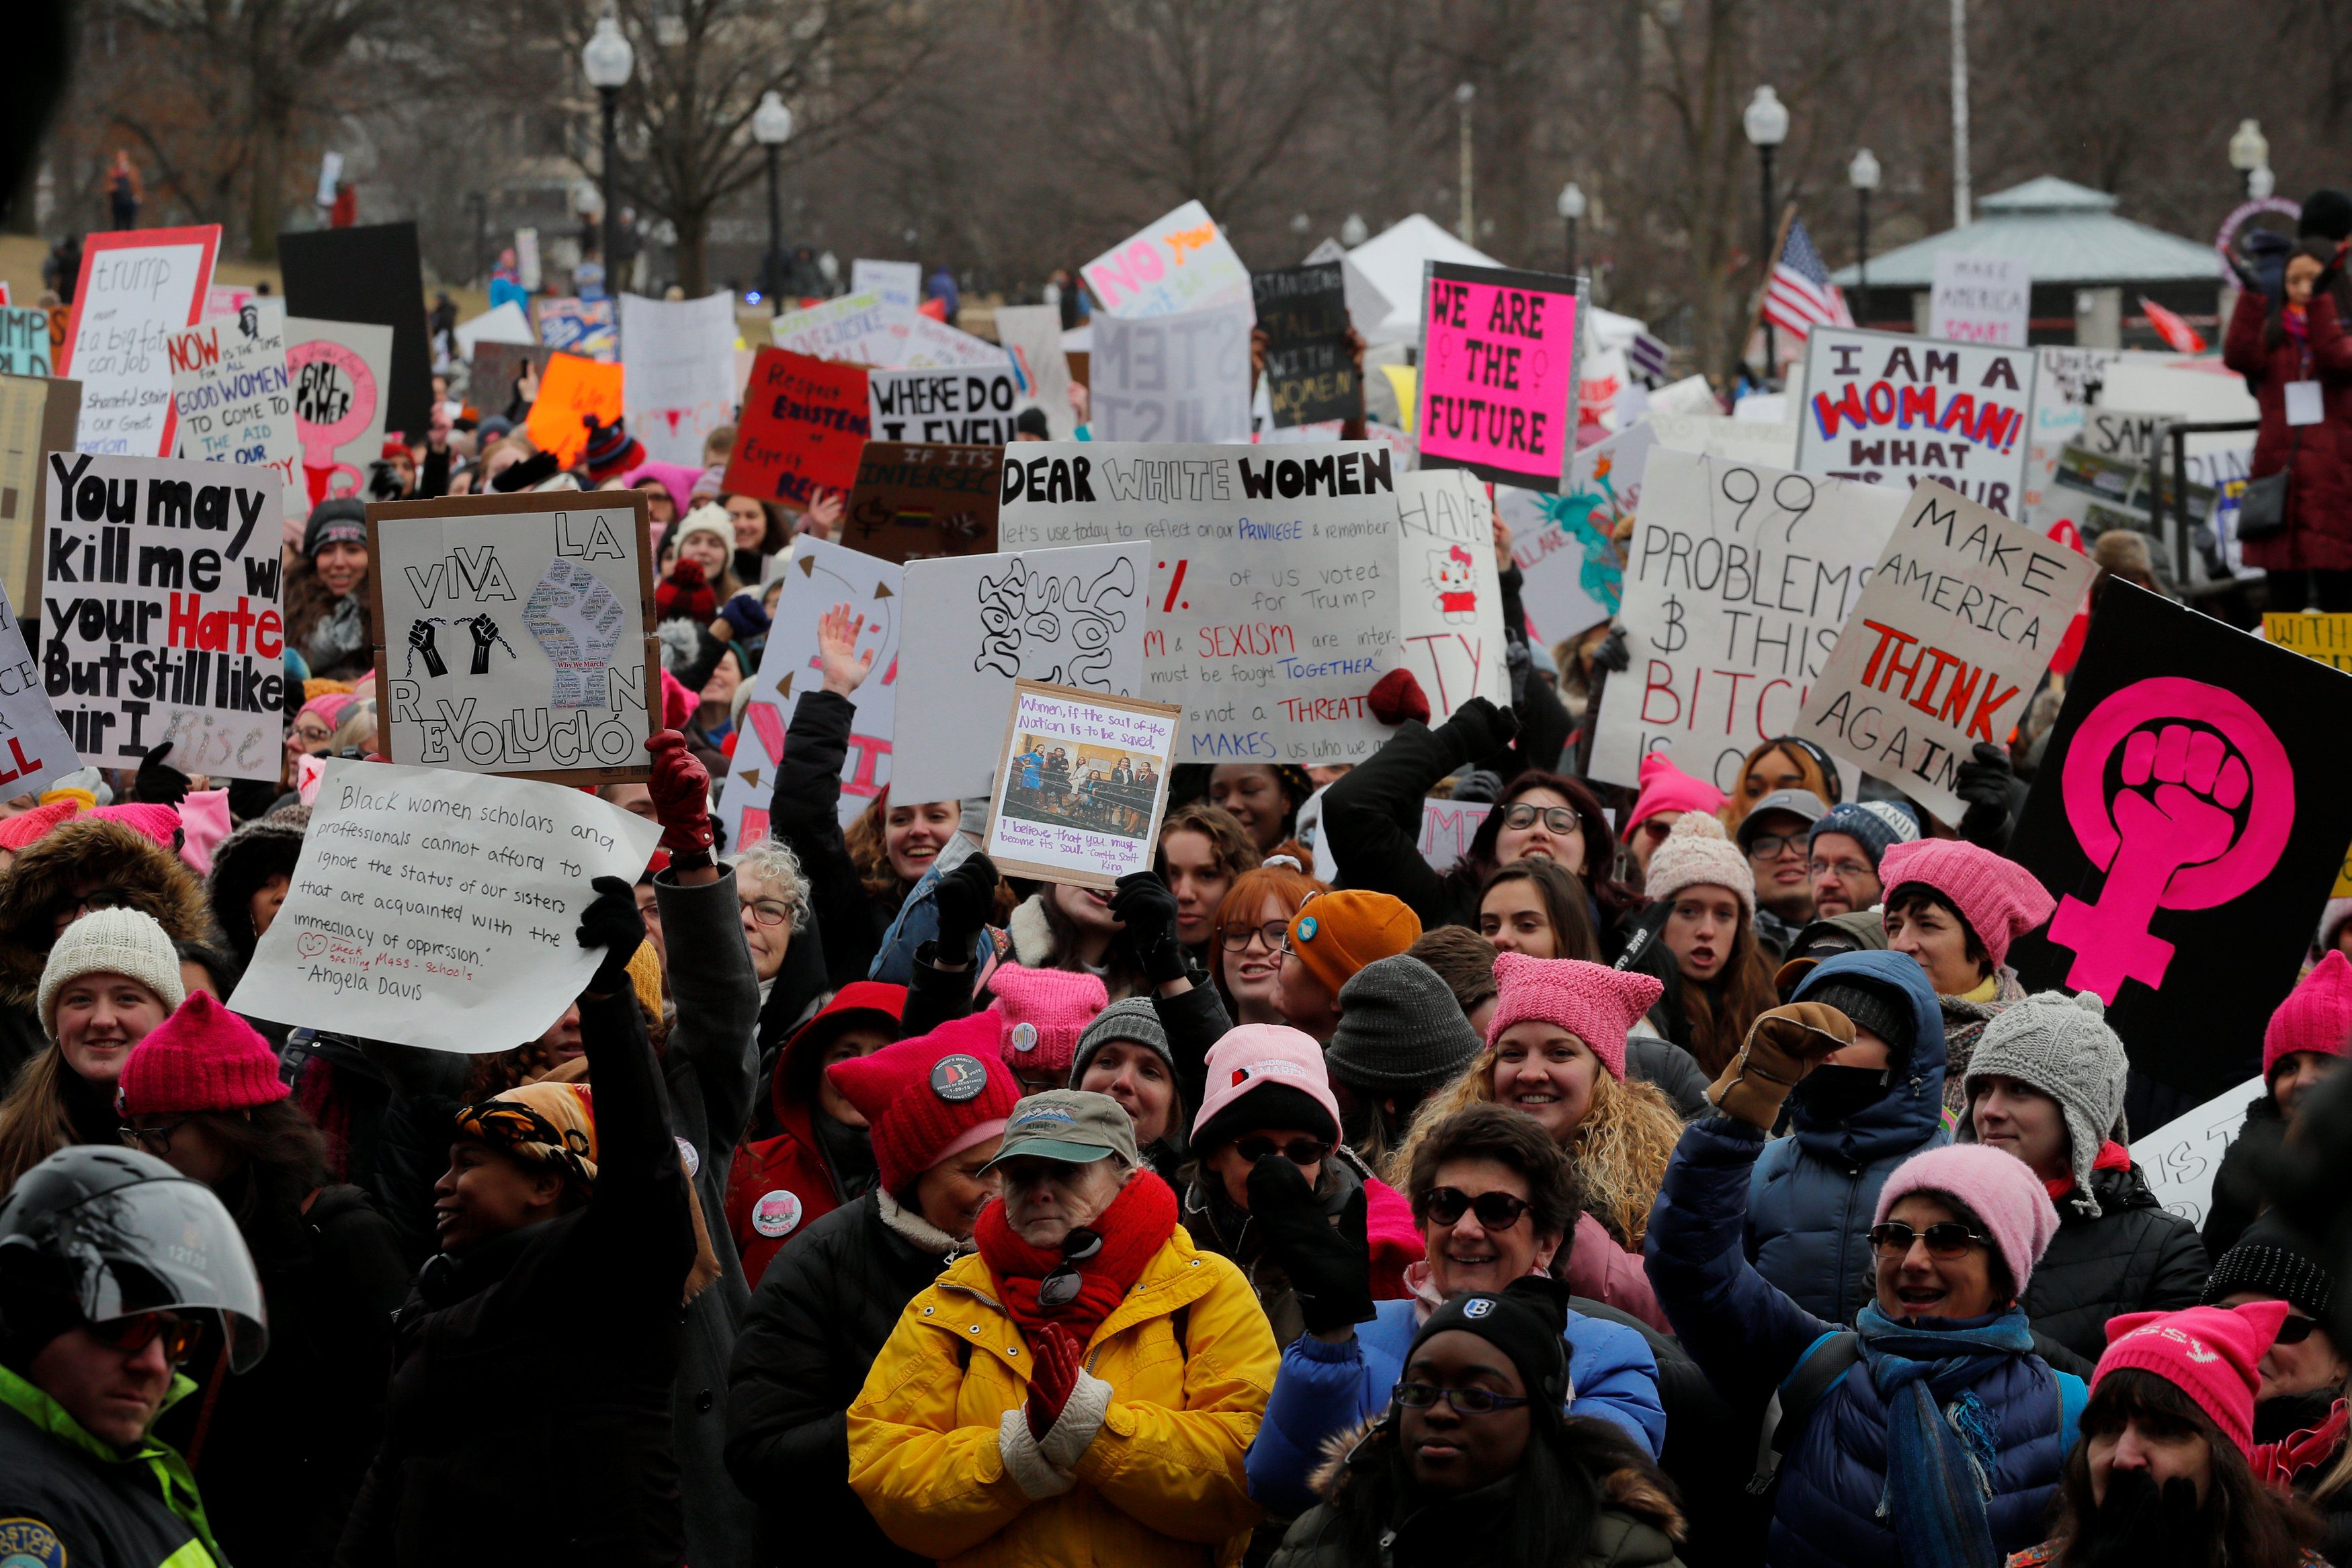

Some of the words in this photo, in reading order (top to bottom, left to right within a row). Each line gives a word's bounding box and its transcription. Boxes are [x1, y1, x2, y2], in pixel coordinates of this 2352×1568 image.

[96, 258, 170, 302] trump
[1090, 239, 1165, 307] NO
[1432, 281, 1469, 329] WE
[1488, 290, 1545, 340] ARE
[108, 328, 134, 354] big
[138, 318, 167, 353] fat
[167, 326, 220, 375] NOW
[236, 345, 253, 357] THE
[226, 361, 245, 374] ALL
[302, 361, 340, 392] GIRL
[1465, 339, 1522, 391] THE
[1831, 346, 1862, 376] I
[1884, 347, 1958, 384] AM
[1981, 357, 2020, 390] A
[175, 386, 219, 417] GOOD
[218, 362, 290, 402] WOMEN
[296, 387, 350, 425] POWER
[872, 376, 959, 415] WHERE
[967, 376, 1014, 413] DO
[1269, 372, 1352, 412] WOMEN
[187, 416, 212, 434] TO
[222, 404, 265, 427] COME
[268, 396, 290, 415] TO
[882, 423, 905, 441] I
[1429, 394, 1547, 455] FUTURE
[1812, 381, 2023, 456] WOMAN!
[202, 435, 230, 453] THE
[243, 424, 271, 442] AID
[235, 444, 266, 464] OUR
[903, 448, 935, 464] IF
[1851, 439, 1970, 469] WHAT
[1001, 456, 1096, 506] DEAR
[1102, 458, 1230, 504] WHITE
[1238, 448, 1394, 500] WOMEN
[50, 453, 138, 524] You
[146, 479, 265, 561] may
[1722, 468, 1816, 542] 99
[555, 512, 626, 561] LA
[1002, 521, 1040, 543] let's
[1047, 527, 1069, 542] use
[1073, 521, 1109, 543] today
[1116, 521, 1132, 537] to
[1144, 518, 1190, 538] reflect
[1325, 520, 1391, 539] remember
[1913, 498, 2067, 597] MAKE
[138, 546, 222, 593] me
[244, 545, 283, 604] w/
[404, 546, 517, 609] VIVA
[1230, 569, 1252, 586] of
[1320, 560, 1380, 585] voted
[1251, 591, 1286, 611] for
[1301, 589, 1376, 610] Trump
[1878, 554, 2040, 650] AMERICA
[44, 597, 163, 645] your
[1198, 622, 1296, 658] SEXISM
[1312, 633, 1340, 648] are
[42, 639, 128, 698] But
[215, 653, 284, 713] like
[1151, 664, 1189, 683] must
[1200, 665, 1222, 683] be
[1860, 618, 2021, 744] THINK
[1020, 695, 1066, 718] Women,
[1068, 705, 1079, 720] if
[1081, 709, 1104, 723] the
[1108, 713, 1131, 726] soul
[1133, 720, 1146, 731] of
[1145, 724, 1166, 736] the
[1206, 701, 1236, 722] not
[1252, 705, 1267, 720] a
[1277, 695, 1369, 723] THREAT
[1641, 659, 1808, 742] BITC
[118, 701, 151, 757] I
[1018, 715, 1065, 734] Nation
[1085, 726, 1099, 737] to
[1101, 728, 1116, 740] be
[1120, 733, 1155, 750] saved,
[1191, 732, 1277, 758] MAKES
[1312, 739, 1342, 758] who
[1346, 740, 1368, 755] we
[1815, 691, 1959, 793] AGAIN
[408, 797, 472, 821] women
[480, 805, 554, 834] scholars
[1013, 820, 1052, 838] believe
[1053, 827, 1082, 842] that
[1085, 834, 1105, 846] you
[1110, 837, 1138, 851] must
[421, 836, 480, 857] cannot
[488, 846, 544, 872] afford
[559, 859, 582, 877] to
[999, 831, 1035, 847] become
[1040, 838, 1053, 849] its
[1118, 851, 1139, 864] Scott
[1101, 860, 1124, 875] King
[367, 859, 392, 876] the
[459, 879, 477, 895] of
[480, 883, 507, 898] our
[513, 891, 566, 914] sisters
[299, 880, 333, 898] that
[340, 890, 365, 906] are
[374, 897, 463, 923] acquainted
[472, 914, 513, 936] with
[528, 926, 561, 947] the
[382, 933, 399, 949] of
[378, 976, 422, 1001] Davis
[956, 1056, 973, 1064] MARCH
[968, 1069, 982, 1077] VOTE
